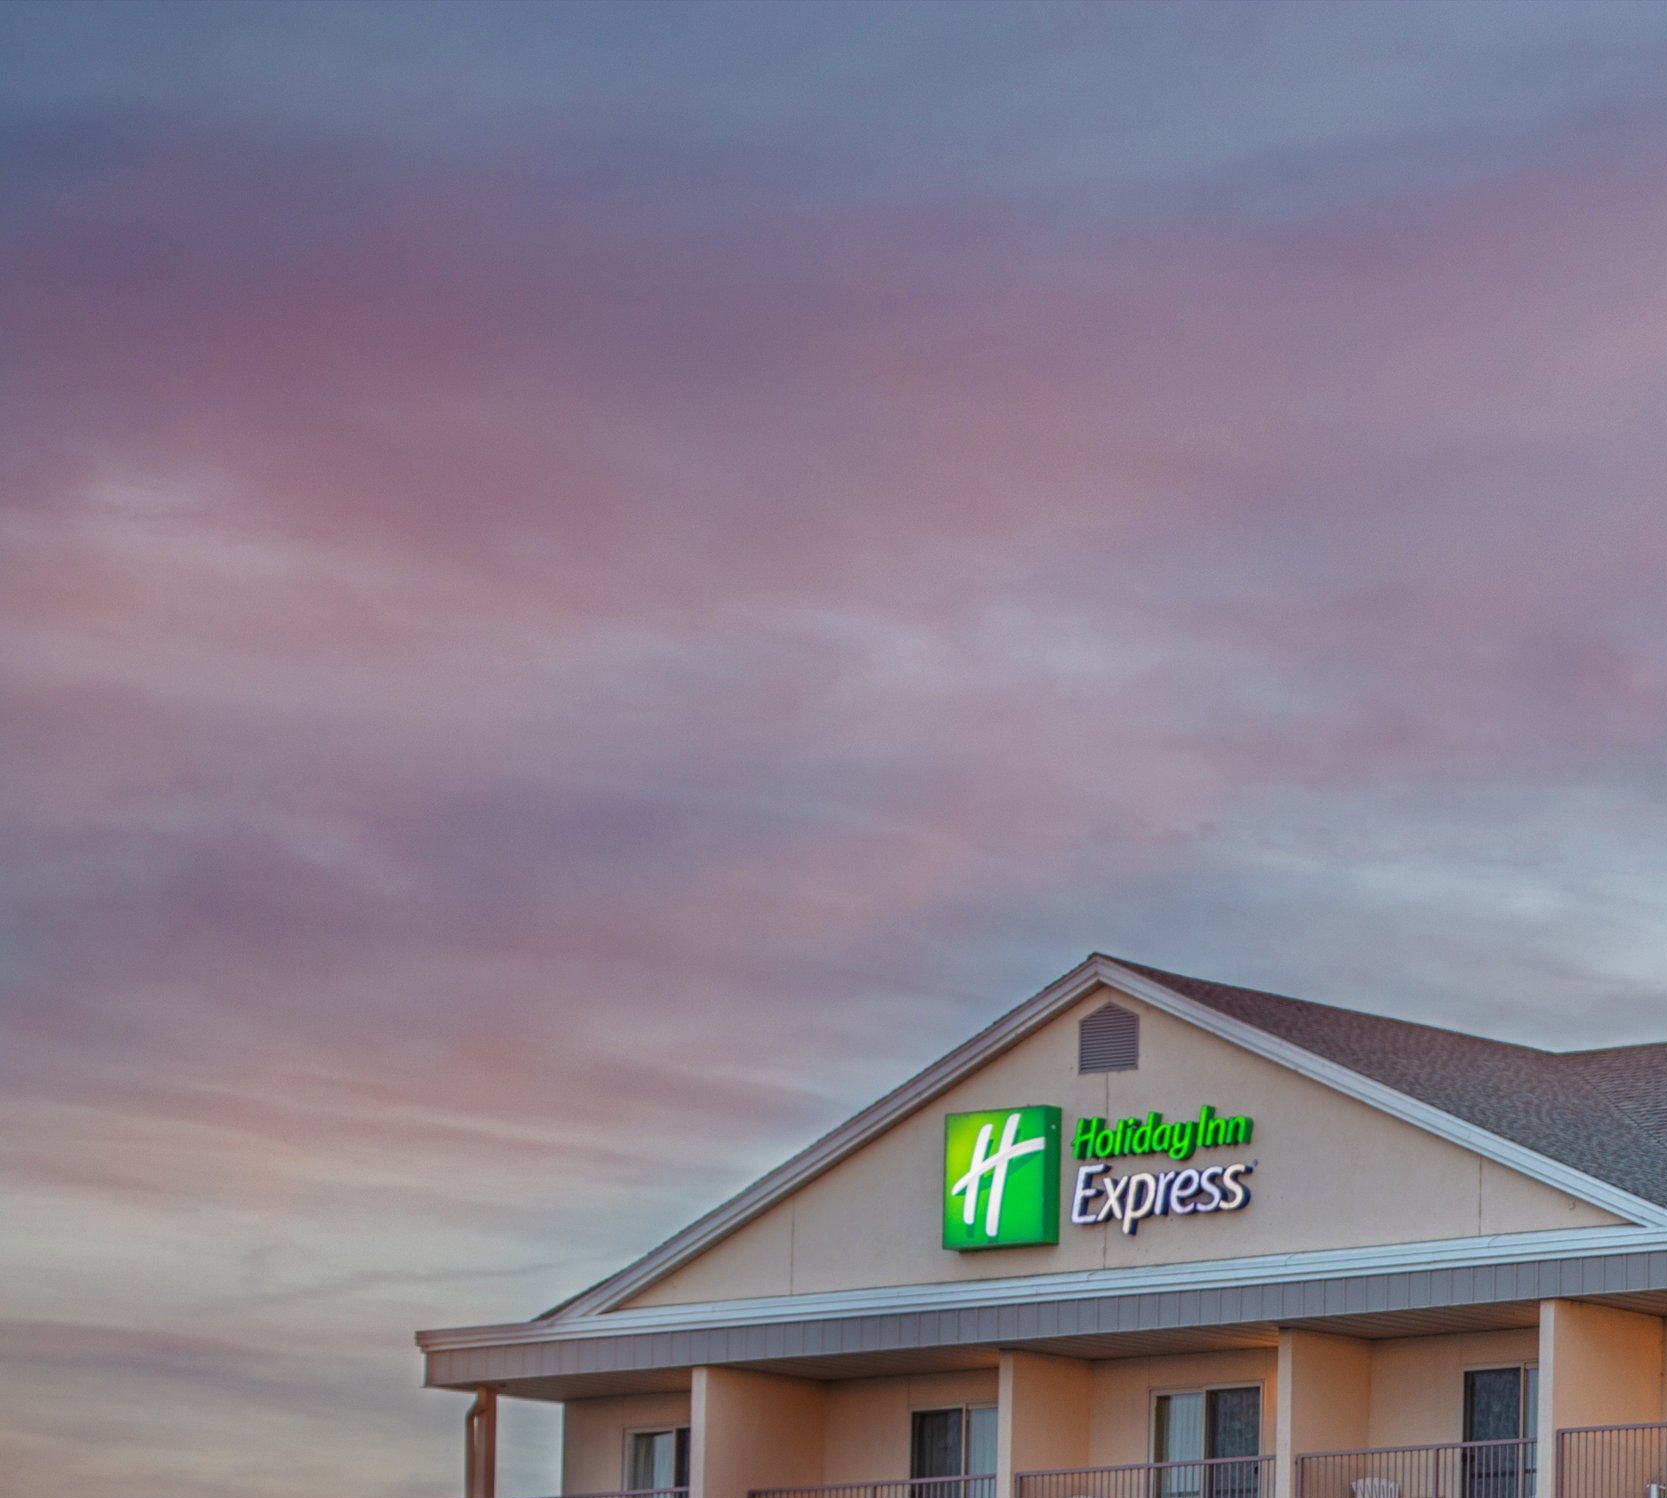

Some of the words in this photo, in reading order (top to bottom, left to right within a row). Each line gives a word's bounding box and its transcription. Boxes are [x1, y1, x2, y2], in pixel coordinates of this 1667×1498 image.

[1072, 1111, 1194, 1161] Holiday
[1197, 1104, 1253, 1148] Inn
[1071, 1163, 1253, 1236] Express
